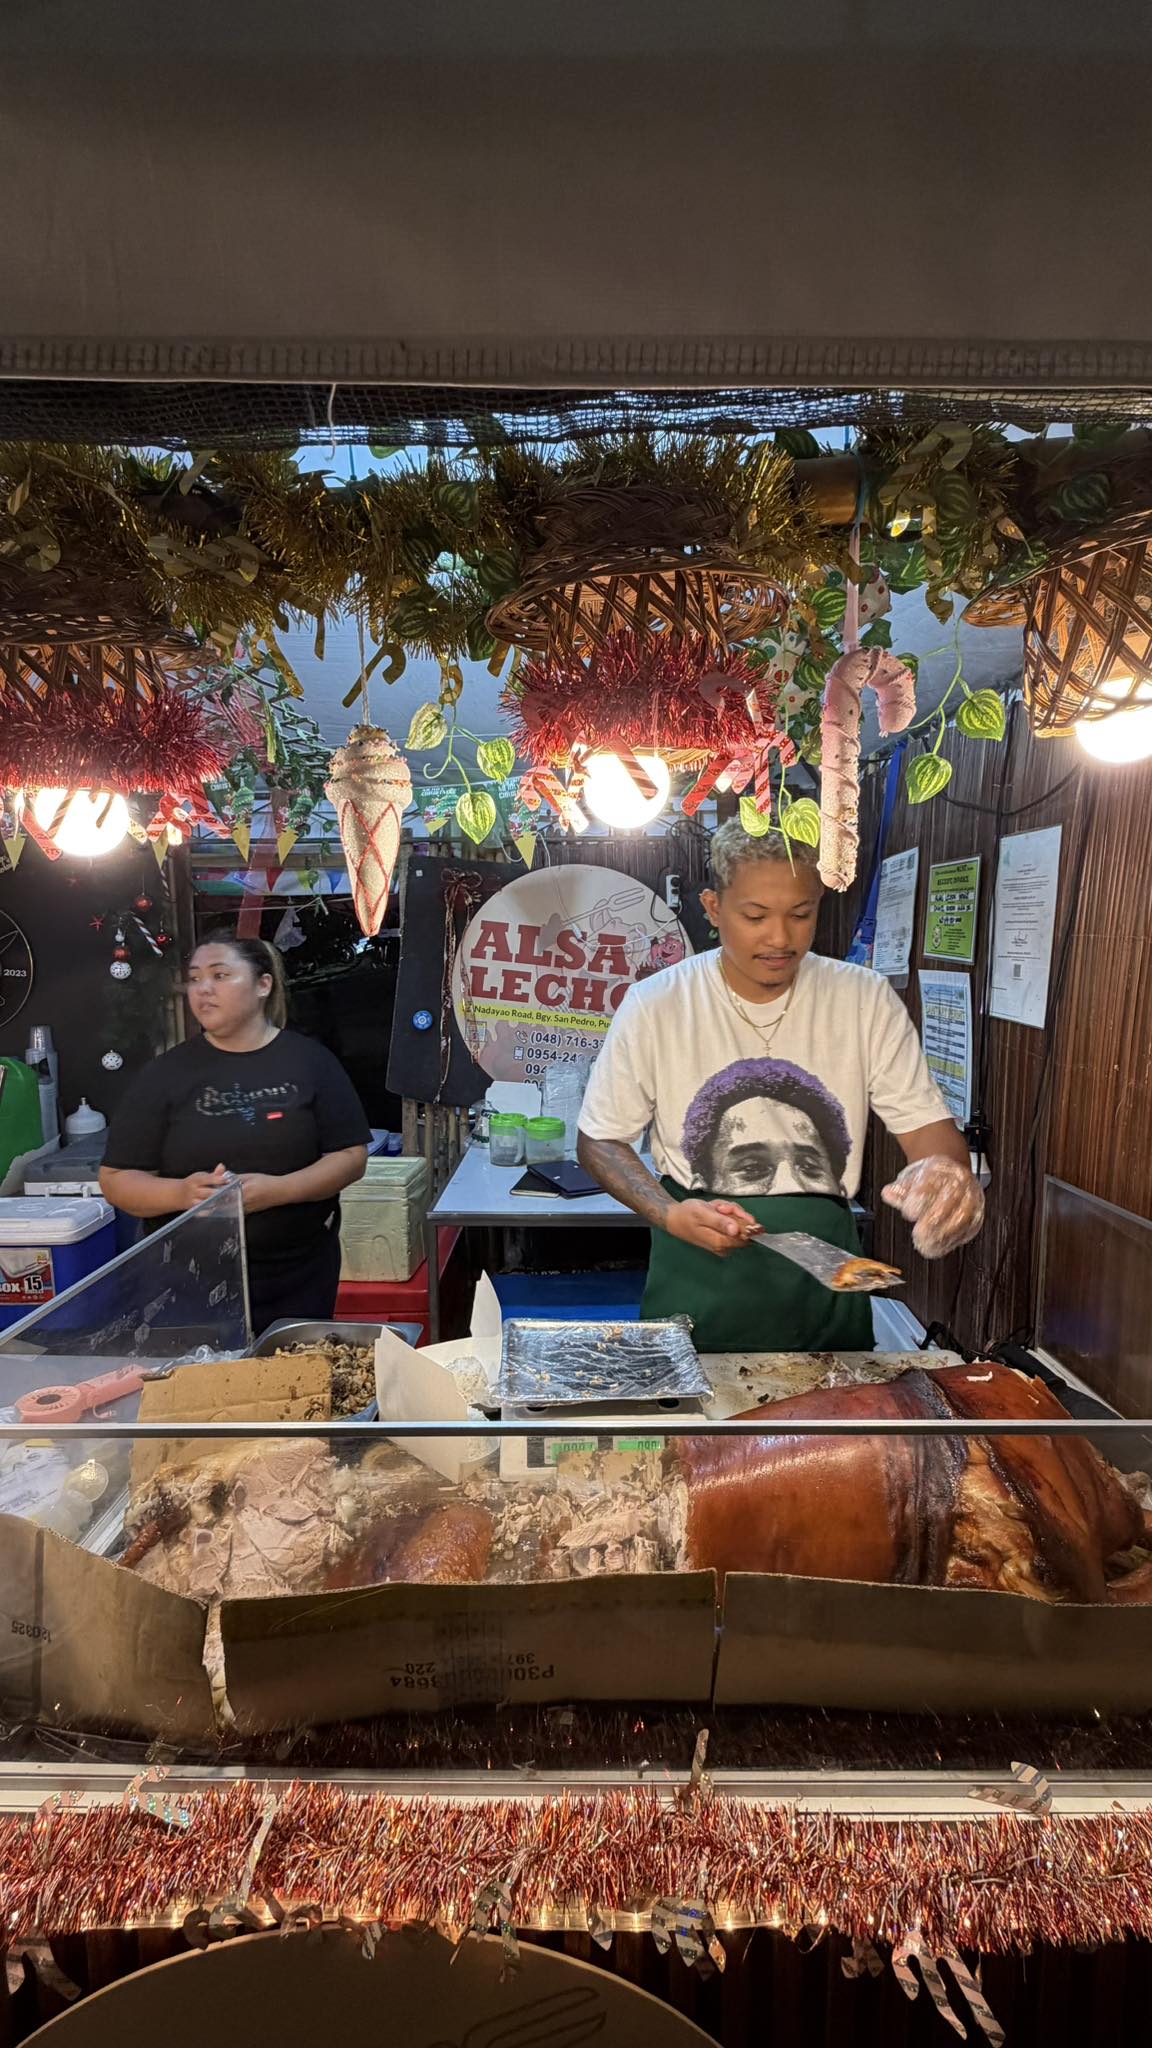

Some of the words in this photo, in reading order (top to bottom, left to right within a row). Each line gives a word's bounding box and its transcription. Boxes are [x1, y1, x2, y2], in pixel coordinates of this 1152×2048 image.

[470, 920, 631, 976] ALSA
[3, 968, 27, 977] 2023
[474, 1005, 510, 1016] Nadayao
[511, 1009, 534, 1020] Road,
[535, 1012, 553, 1023] Bgy.
[554, 1014, 569, 1024] San
[570, 1016, 597, 1028] Pedro,
[530, 1031, 561, 1047] (048)
[0, 1282, 21, 1293] OX
[24, 1276, 43, 1291] 15
